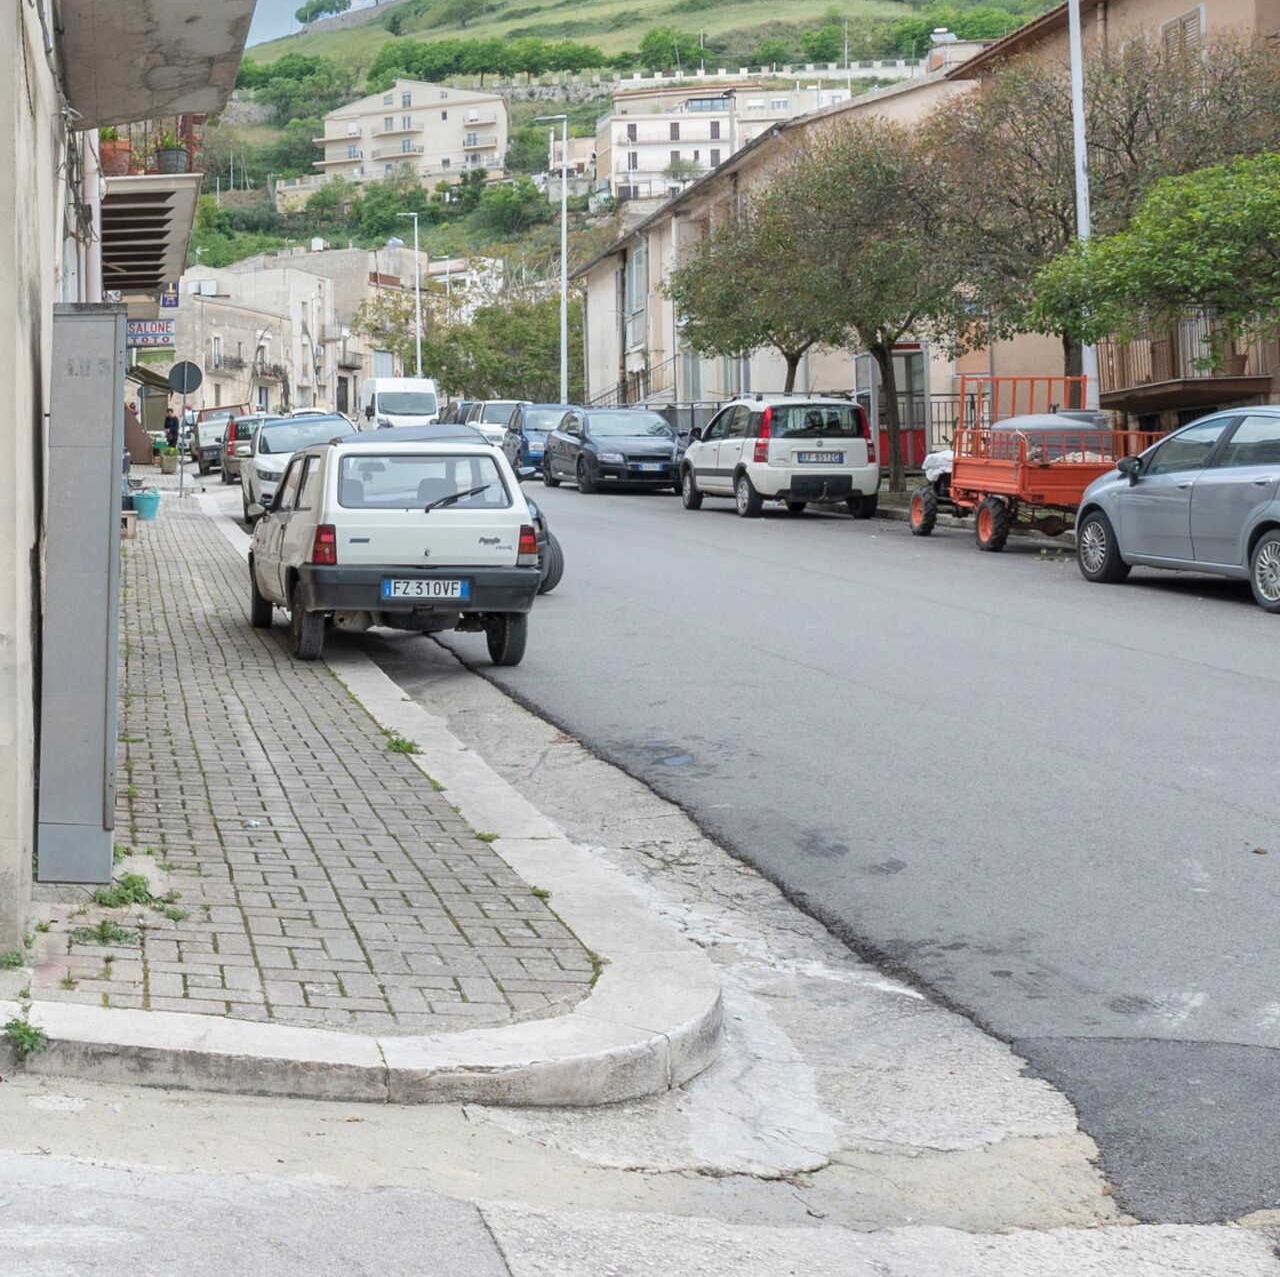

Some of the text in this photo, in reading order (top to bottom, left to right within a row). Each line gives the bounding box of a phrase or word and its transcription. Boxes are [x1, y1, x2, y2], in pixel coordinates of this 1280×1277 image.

[128, 322, 172, 334] SALONE
[131, 336, 170, 344] TOTO
[393, 581, 459, 596] FZ 310VF
